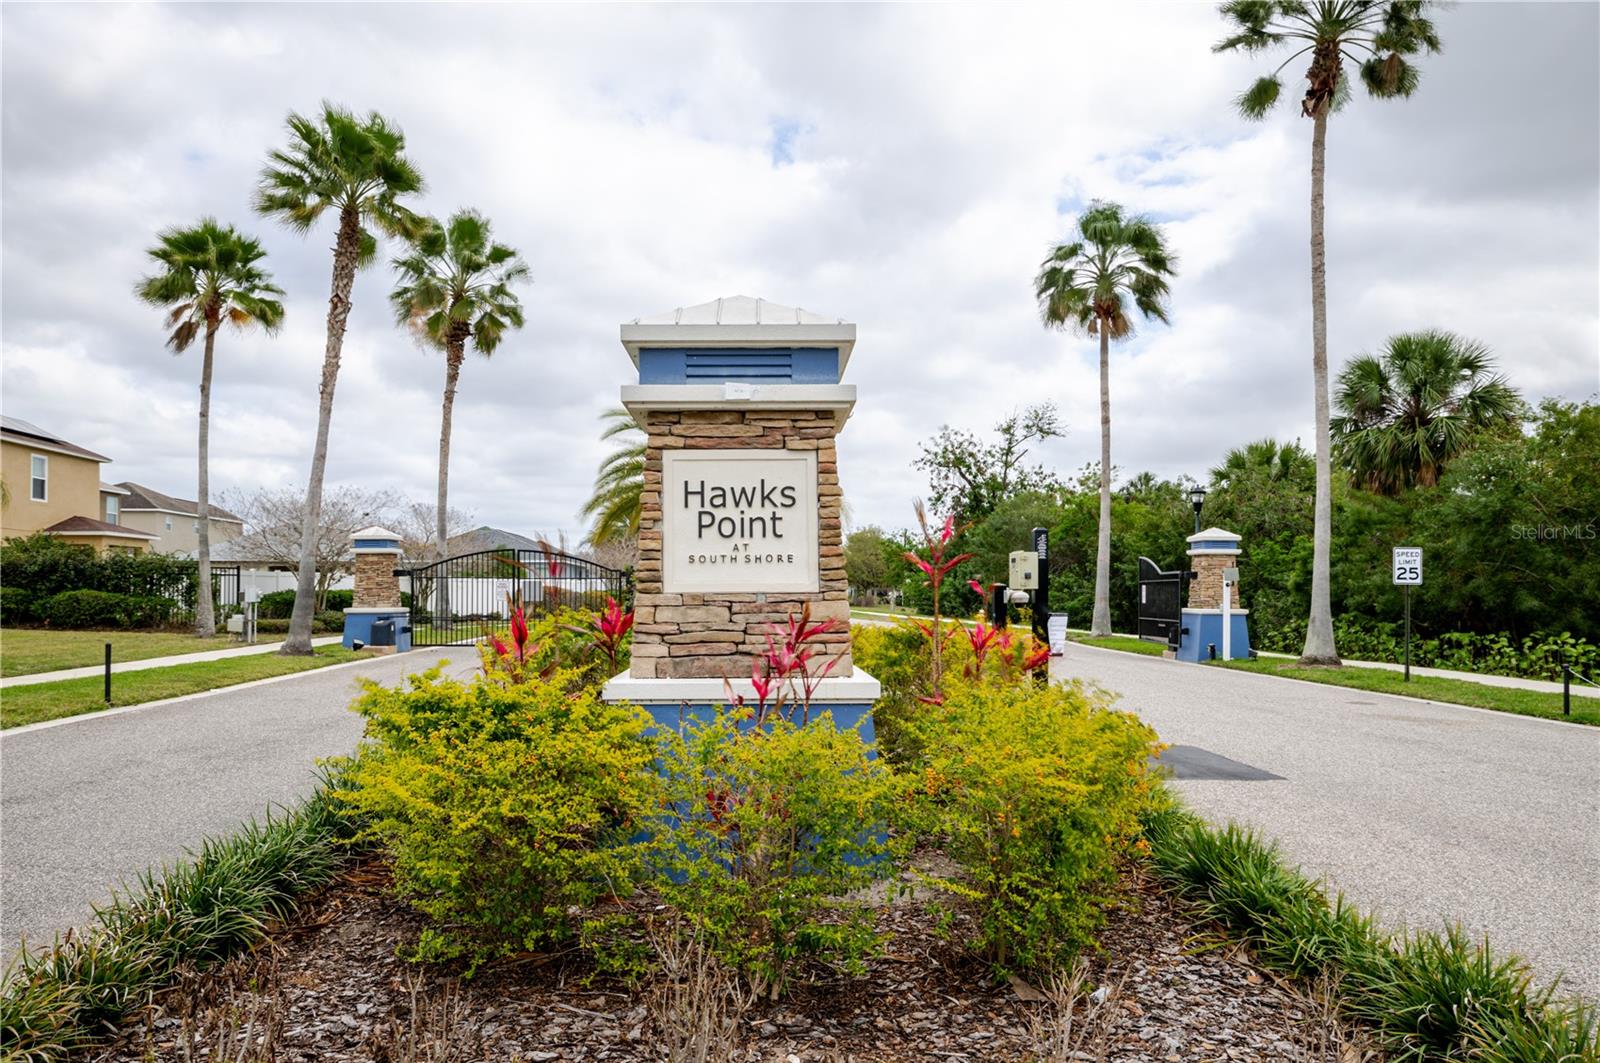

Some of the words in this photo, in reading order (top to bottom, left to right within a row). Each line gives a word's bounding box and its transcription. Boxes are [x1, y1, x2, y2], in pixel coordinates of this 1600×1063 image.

[683, 478, 797, 508] Hawks
[697, 510, 784, 539] Point
[732, 543, 750, 552] AT
[1396, 567, 1420, 580] 25
